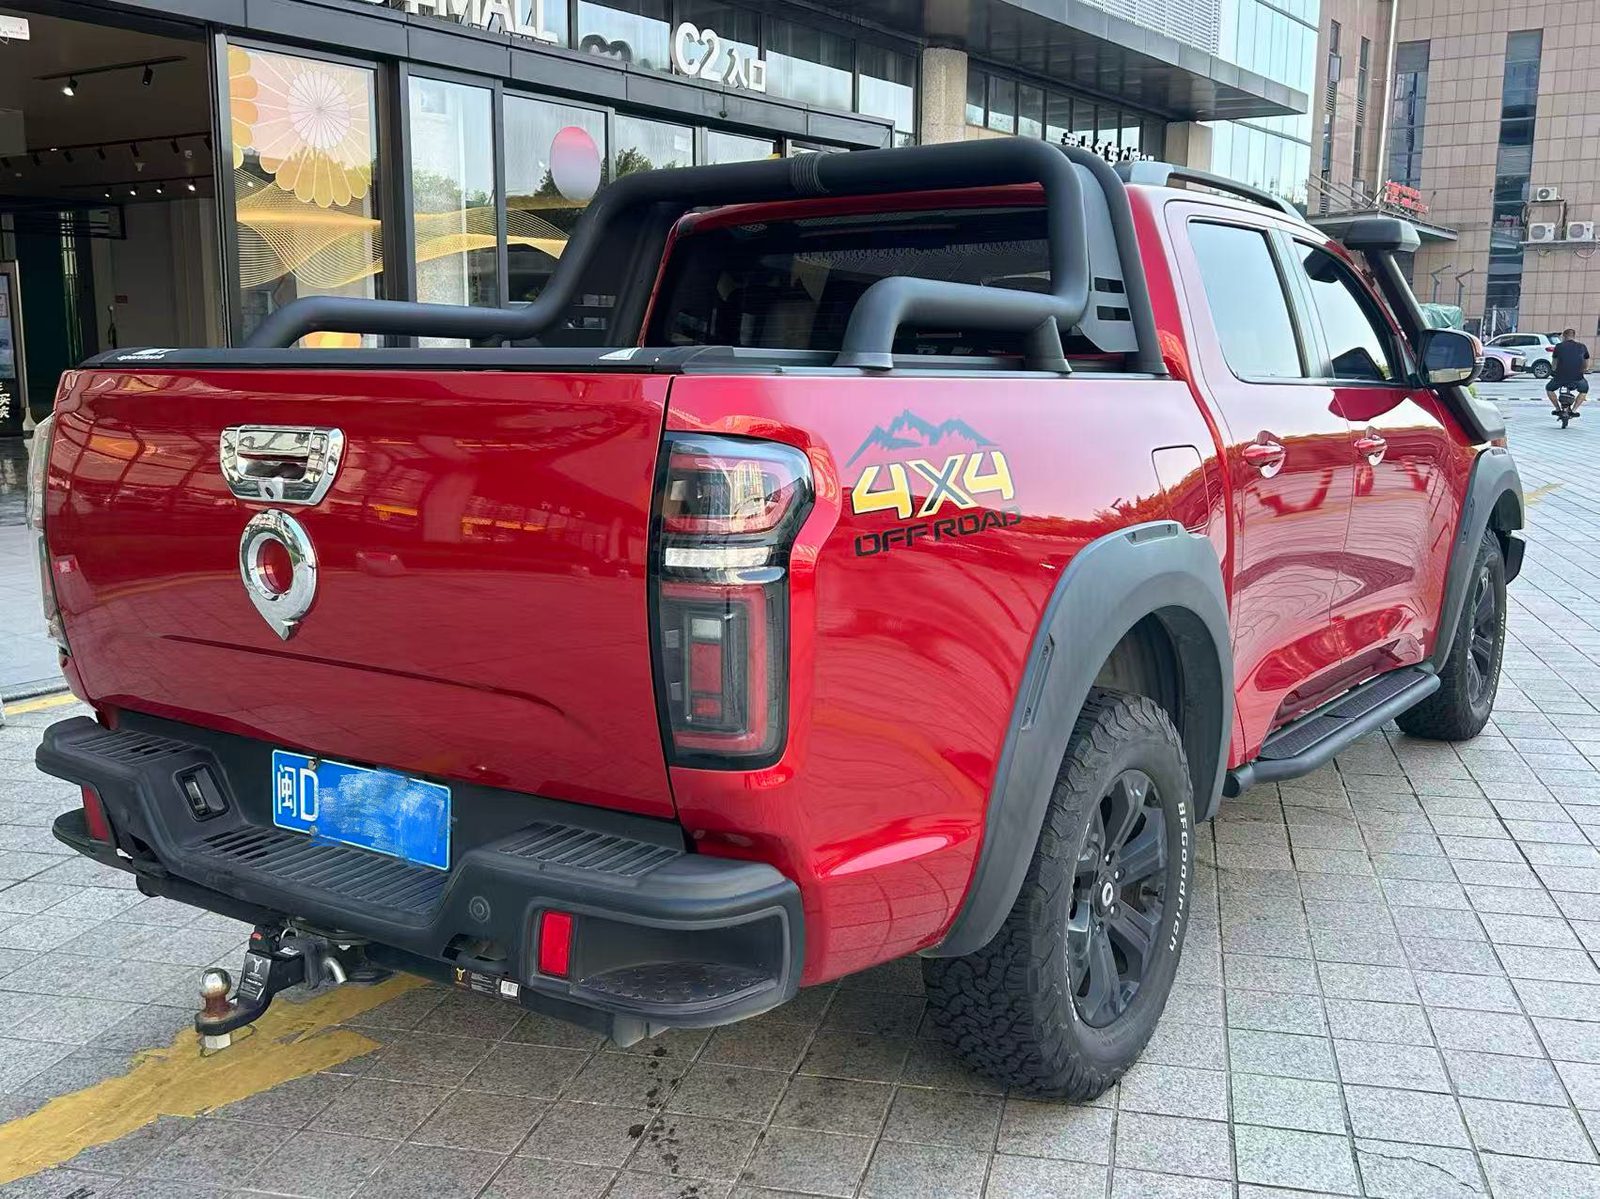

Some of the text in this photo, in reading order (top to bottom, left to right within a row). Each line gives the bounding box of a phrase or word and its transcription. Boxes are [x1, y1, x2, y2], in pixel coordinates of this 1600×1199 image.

[854, 504, 1022, 557] OFF ROAD
[1168, 802, 1188, 952] BFGoodrich
